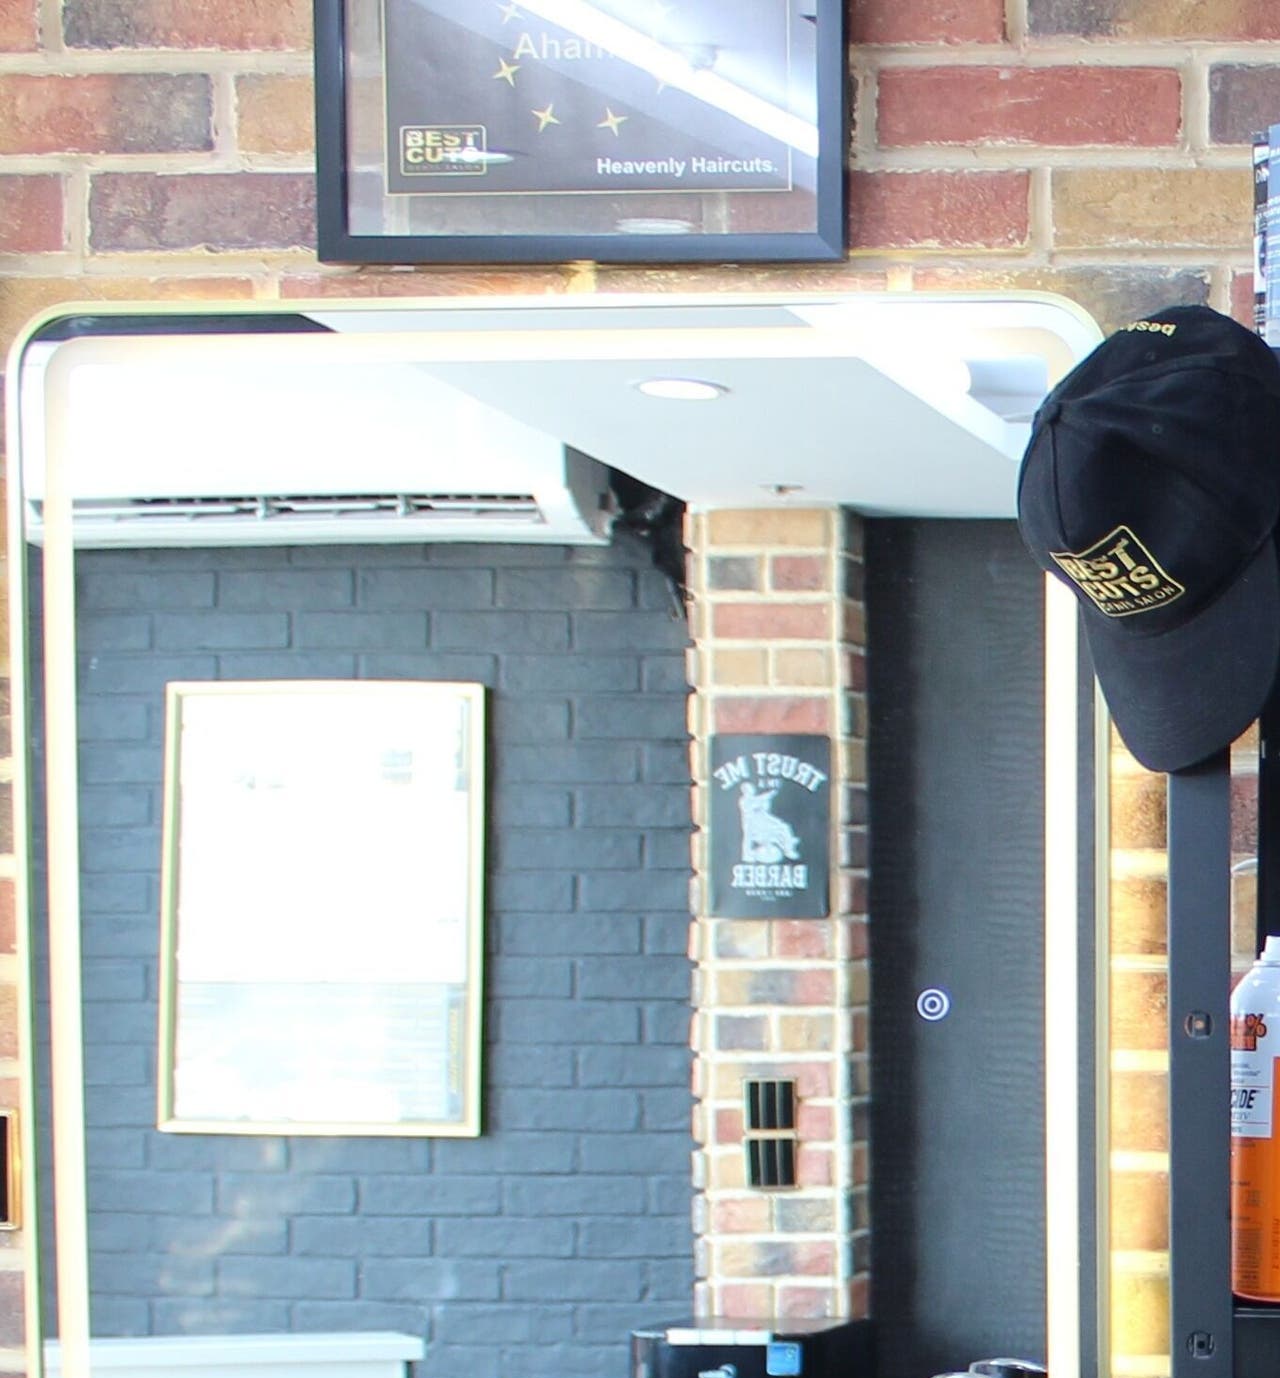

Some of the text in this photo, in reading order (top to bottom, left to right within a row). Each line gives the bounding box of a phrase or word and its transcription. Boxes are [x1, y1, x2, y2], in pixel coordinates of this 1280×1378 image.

[406, 131, 479, 146] BEST
[597, 156, 777, 178] Heavenly Haircuts.
[1058, 537, 1137, 581] BEST
[1079, 565, 1160, 600] CUTS
